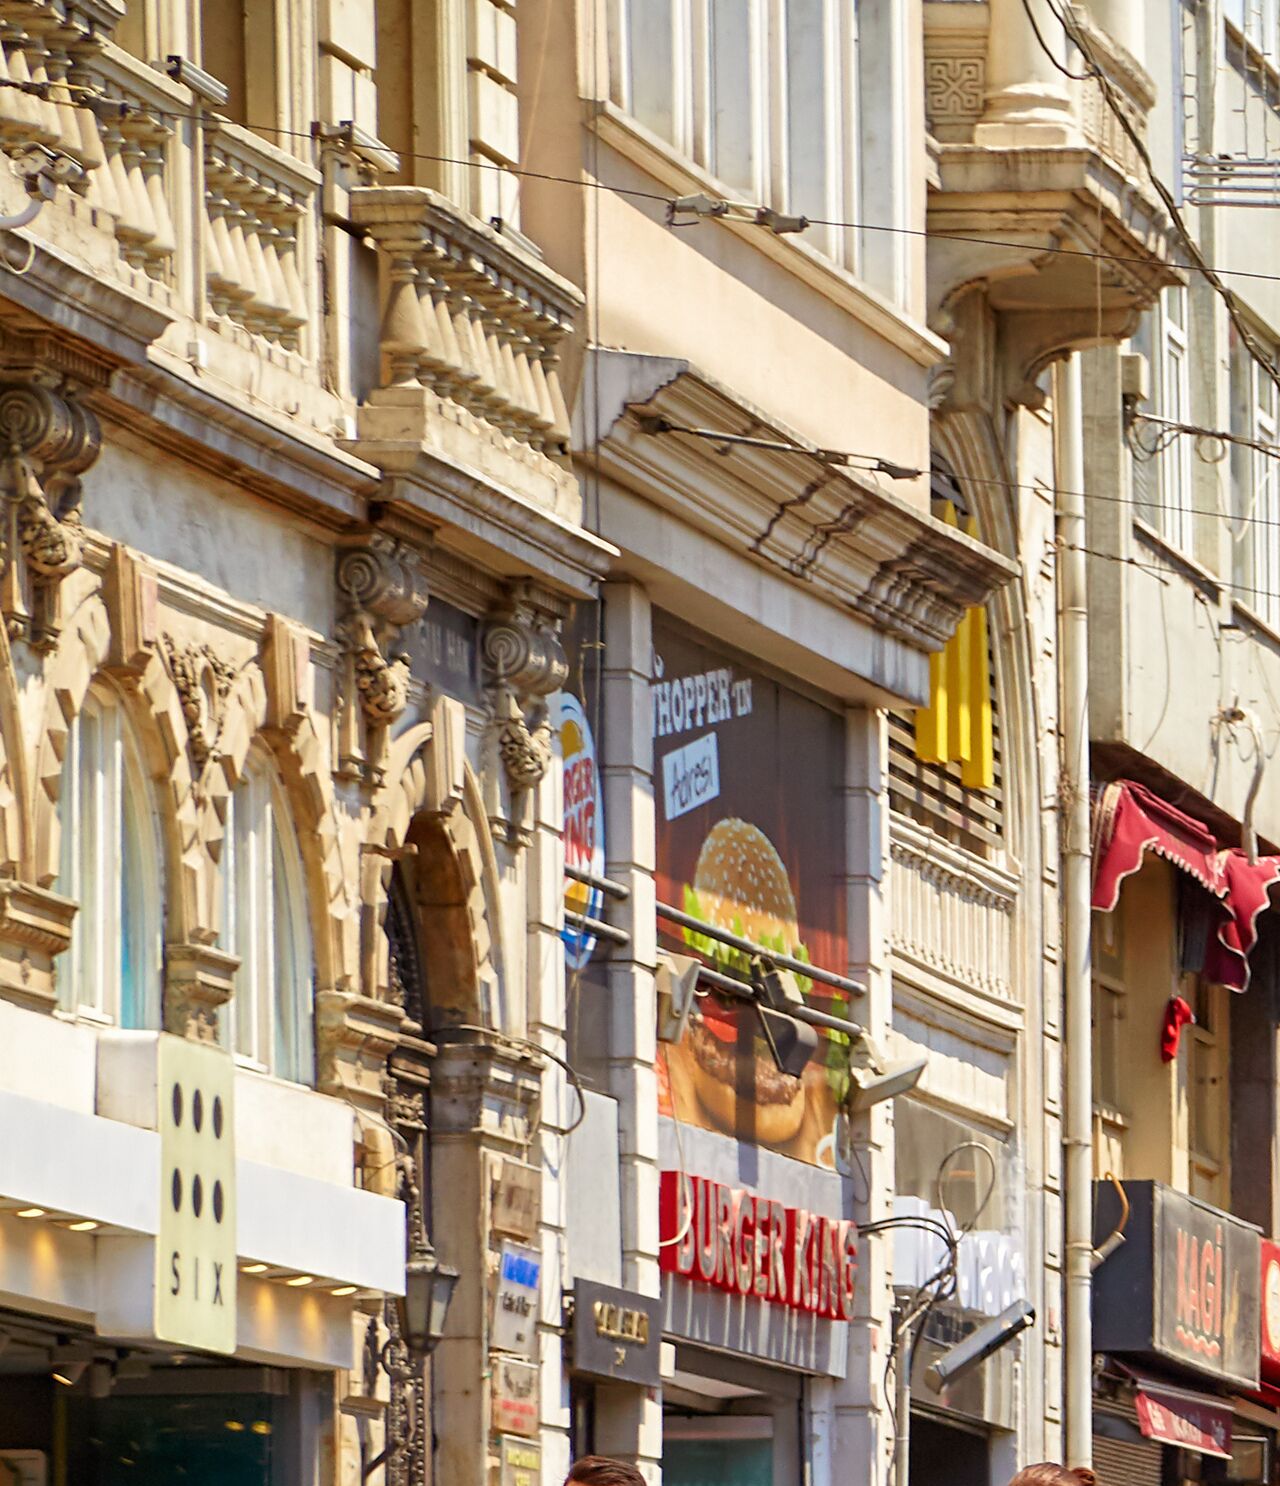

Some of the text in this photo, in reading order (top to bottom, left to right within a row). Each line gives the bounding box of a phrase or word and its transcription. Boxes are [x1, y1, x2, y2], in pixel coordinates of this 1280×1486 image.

[171, 1250, 224, 1306] SIX
[676, 1170, 787, 1305] BURGER
[794, 1208, 859, 1321] KING
